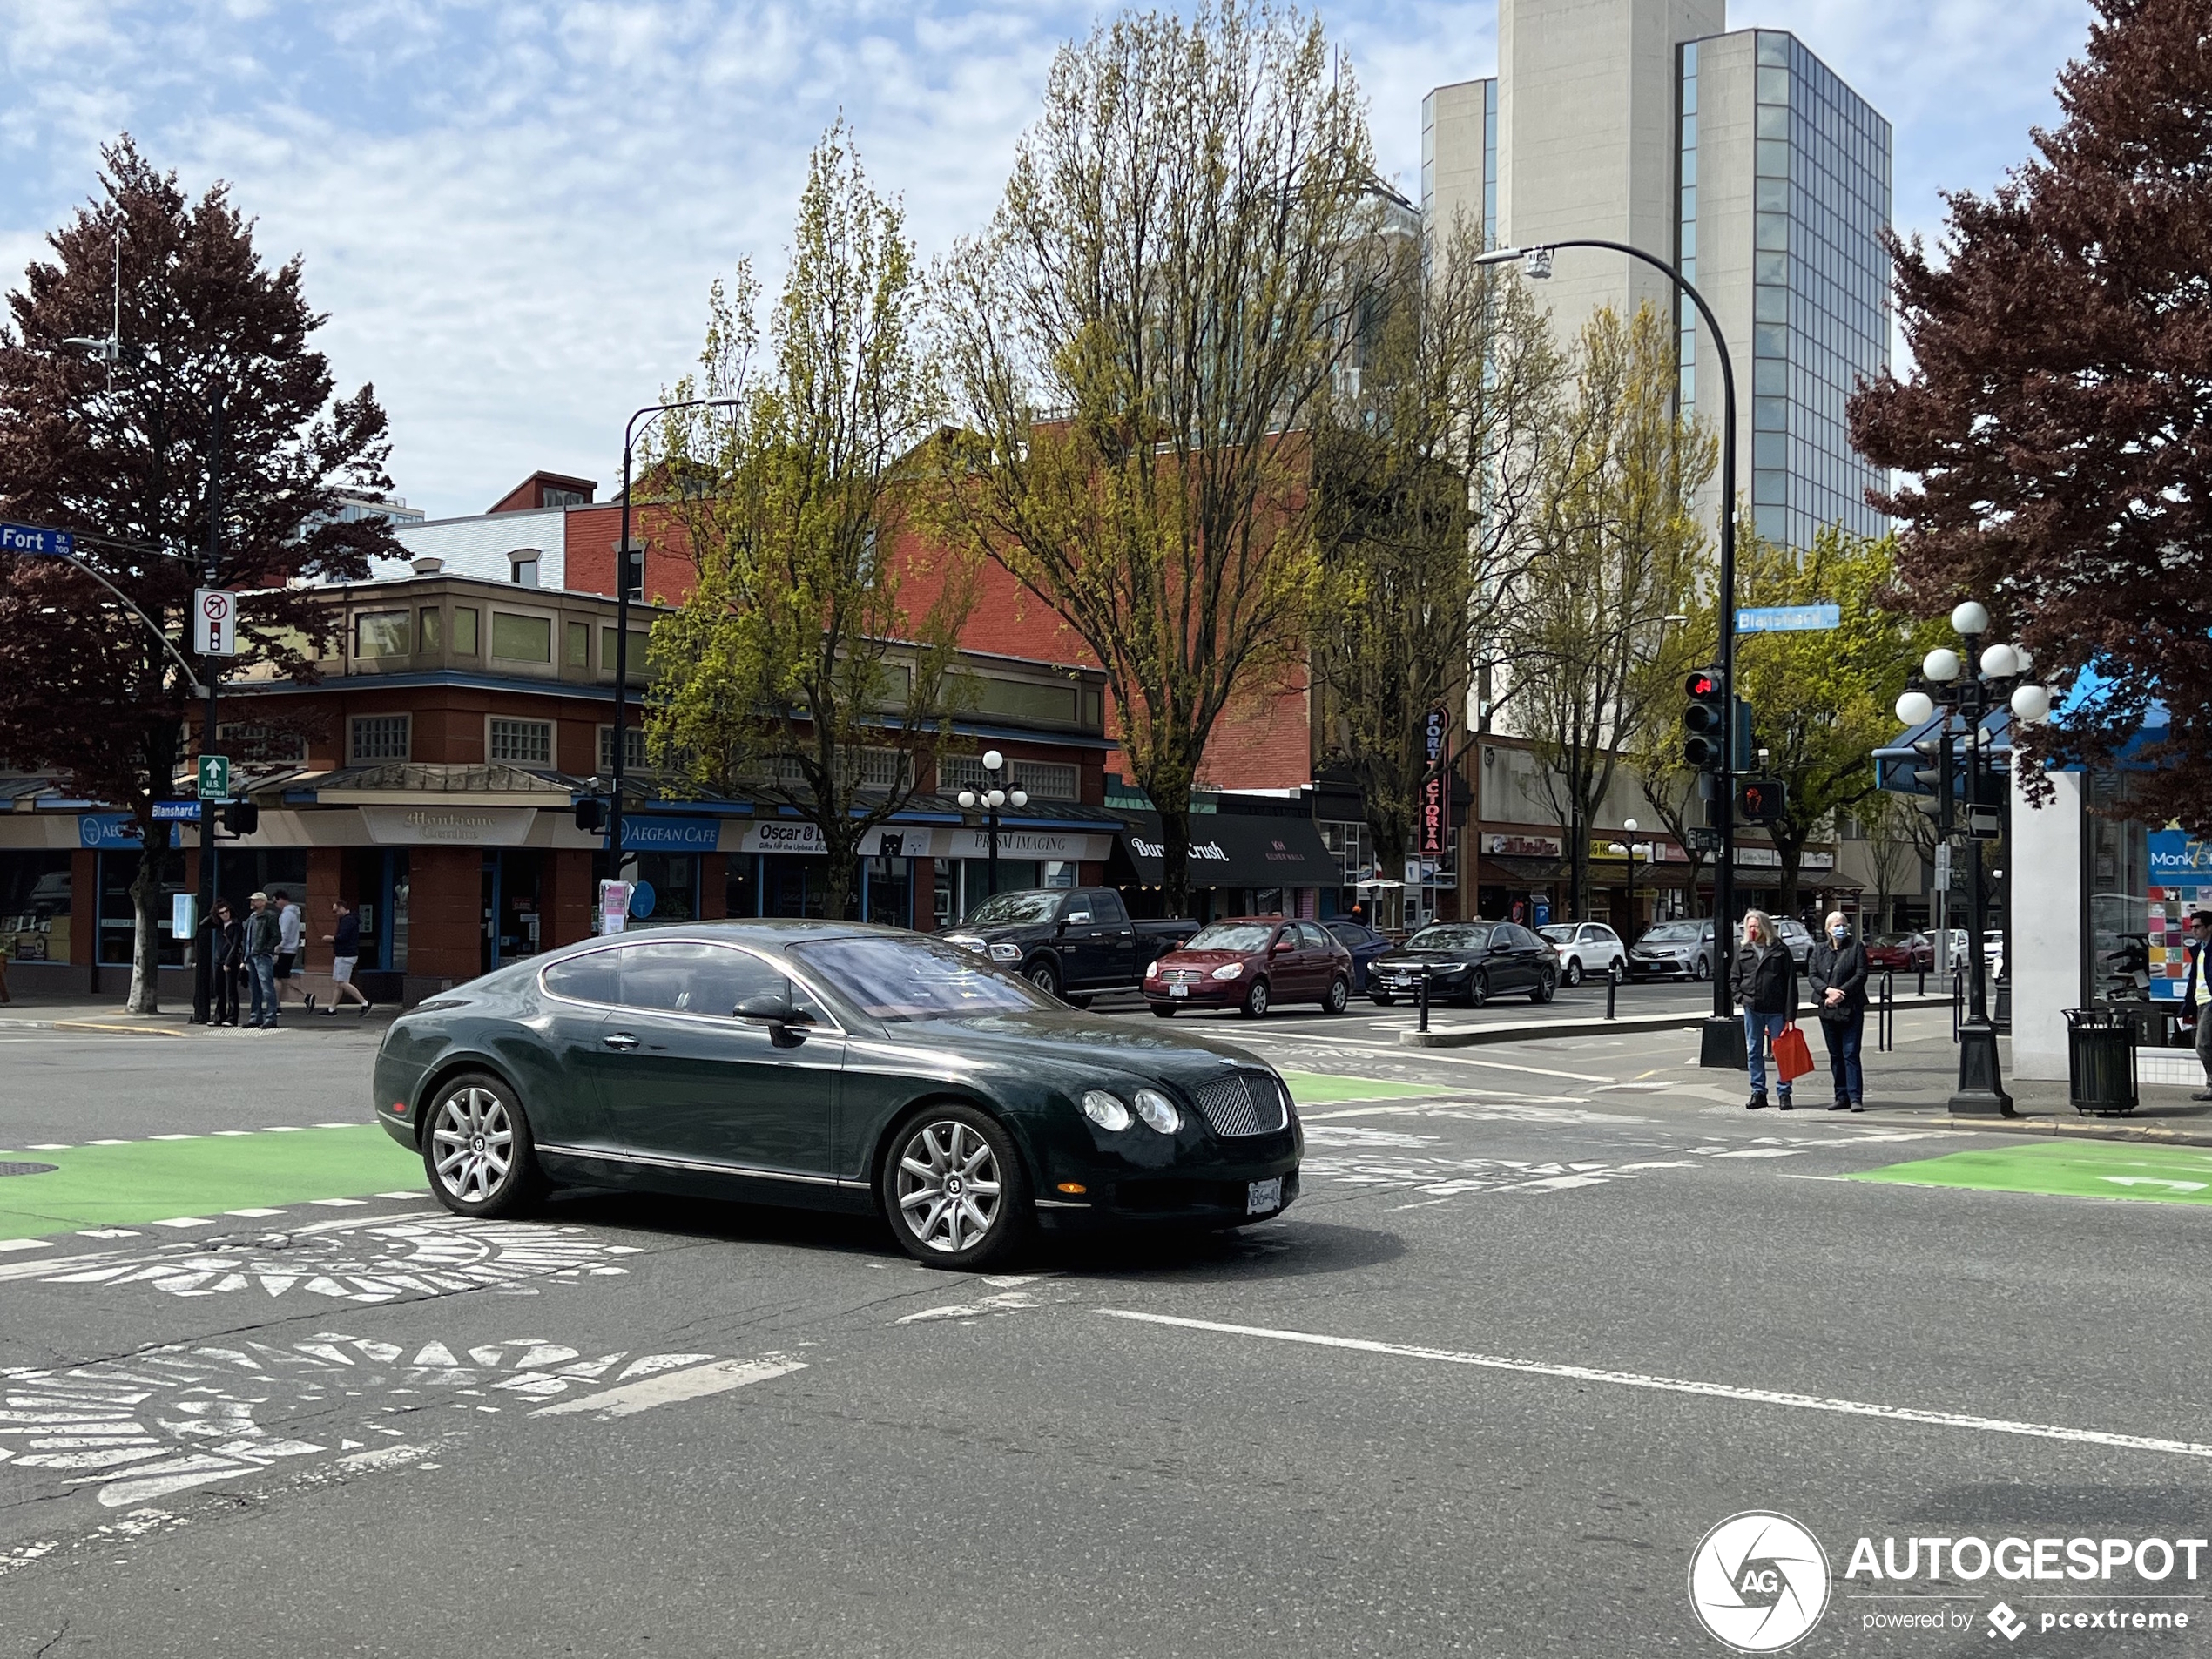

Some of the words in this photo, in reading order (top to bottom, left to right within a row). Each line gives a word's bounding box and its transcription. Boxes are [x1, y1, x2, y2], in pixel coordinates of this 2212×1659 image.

[3, 528, 44, 550] Fort
[55, 545, 70, 554] 700
[206, 779, 220, 788] U.S.
[200, 788, 225, 797] Ferries
[152, 804, 194, 817] Blanshard
[630, 826, 683, 841] AEGEAN
[685, 826, 717, 843] CAFE
[760, 824, 801, 840] Oscar
[803, 826, 814, 841] &
[974, 833, 1013, 849] PRSM
[1016, 835, 1066, 851] IMAGING
[1271, 840, 1286, 851] KH
[2150, 851, 2194, 866] Monk
